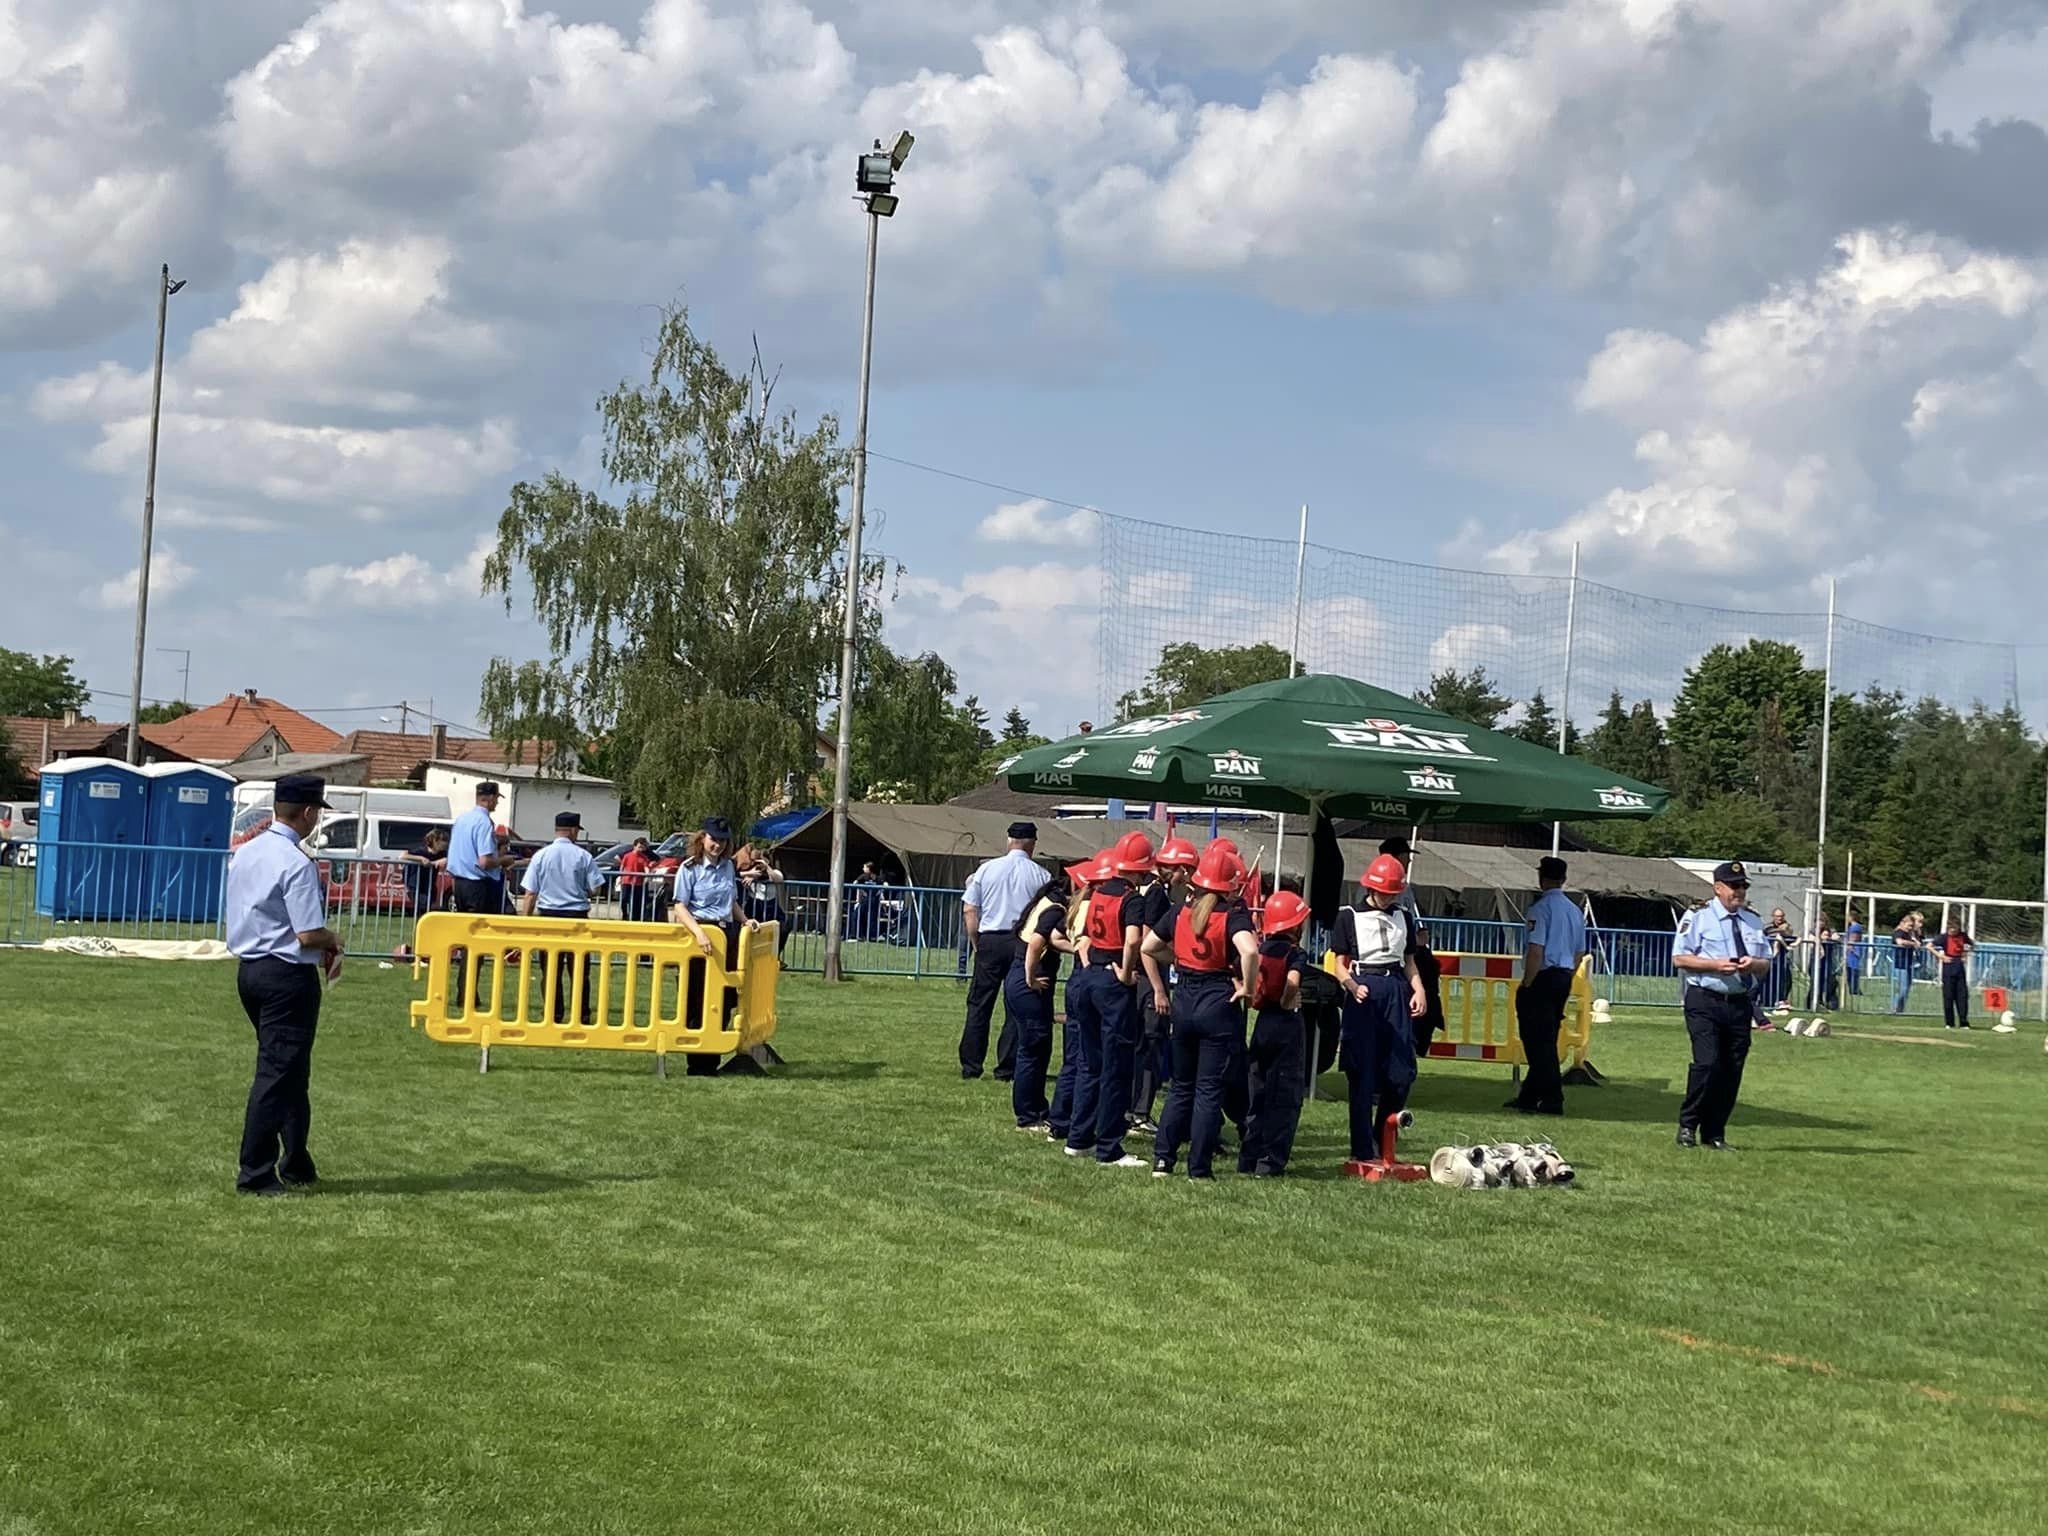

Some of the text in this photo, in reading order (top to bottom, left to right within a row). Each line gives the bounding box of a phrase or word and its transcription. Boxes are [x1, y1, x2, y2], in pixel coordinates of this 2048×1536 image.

[1327, 728, 1474, 754] PAN
[1132, 754, 1157, 770] PAN
[1214, 758, 1260, 774] PAN
[1409, 775, 1455, 790] PAN
[1599, 793, 1645, 806] PAN
[1092, 904, 1106, 939] 5
[1378, 918, 1391, 953] 1
[1991, 992, 2001, 1008] 2
